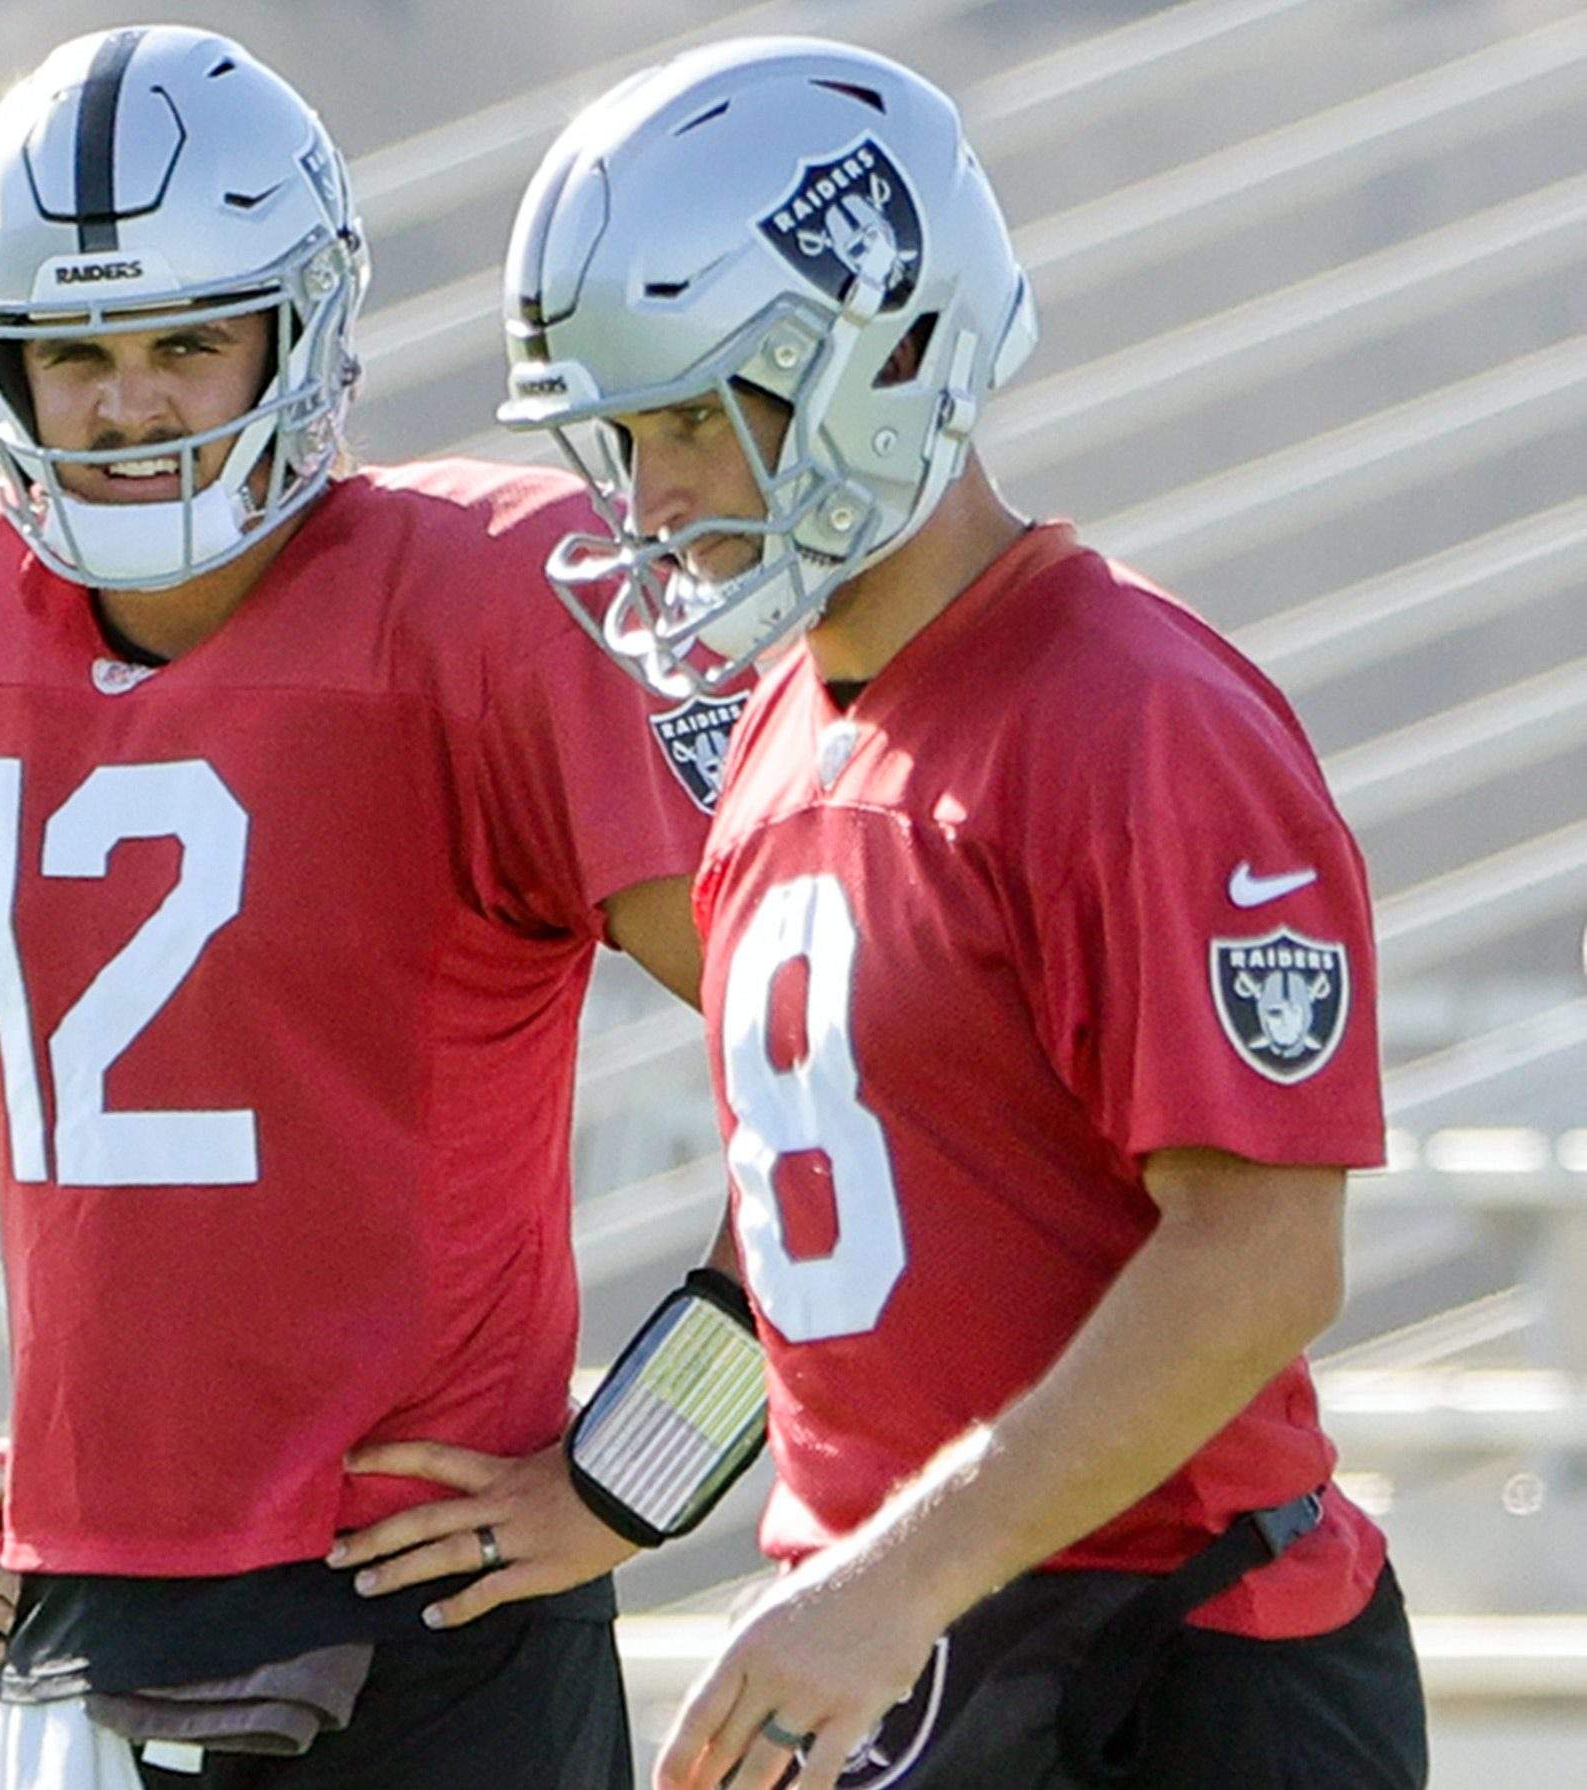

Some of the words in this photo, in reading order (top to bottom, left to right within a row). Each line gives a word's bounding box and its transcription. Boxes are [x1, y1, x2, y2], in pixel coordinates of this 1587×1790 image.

[773, 149, 876, 234] RAIDERS
[56, 260, 144, 285] RAIDERS
[660, 704, 743, 740] RAIDERS
[1230, 947, 1335, 971] RAIDERS
[722, 873, 906, 1344] 8
